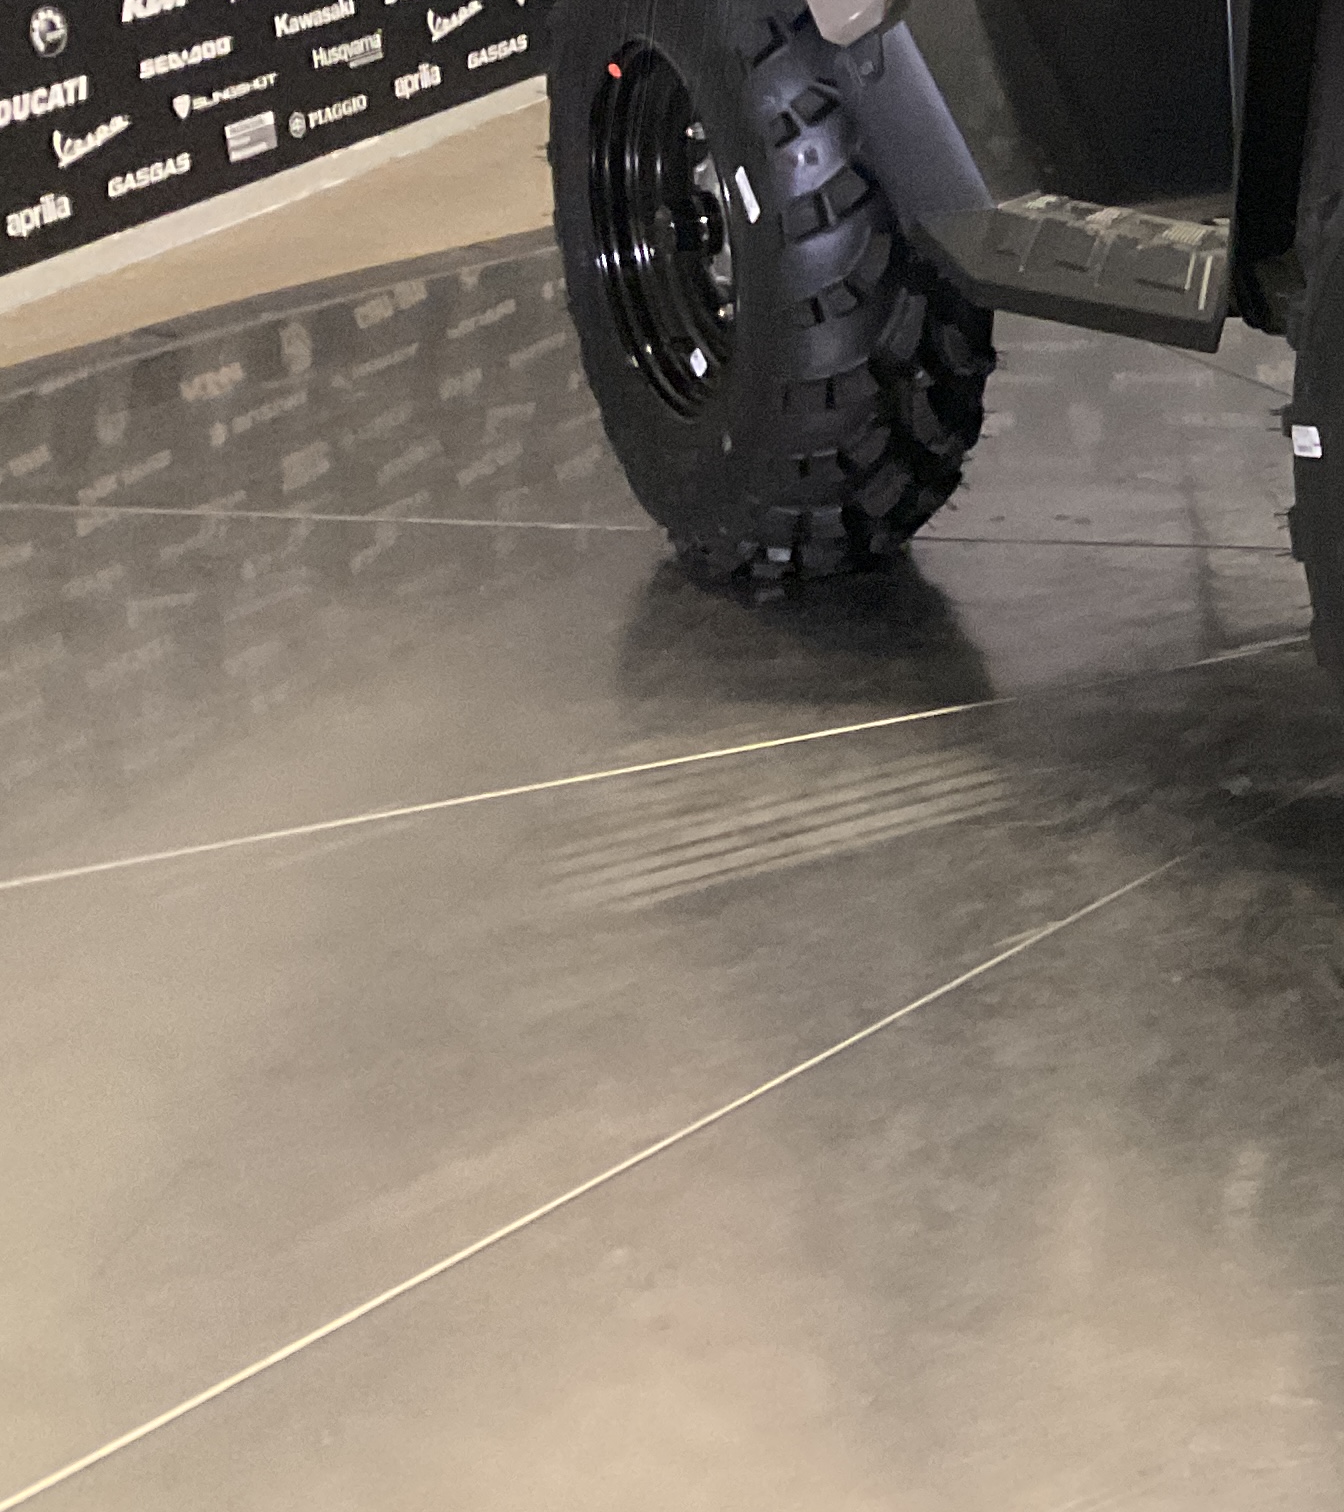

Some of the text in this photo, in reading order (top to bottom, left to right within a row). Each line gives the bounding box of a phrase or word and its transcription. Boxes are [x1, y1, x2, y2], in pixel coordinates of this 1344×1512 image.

[467, 33, 528, 70] GASGAS
[394, 63, 442, 100] aprilia
[307, 94, 367, 129] PIAGGIO
[107, 152, 191, 198] GASGAS
[6, 192, 72, 238] aprilia
